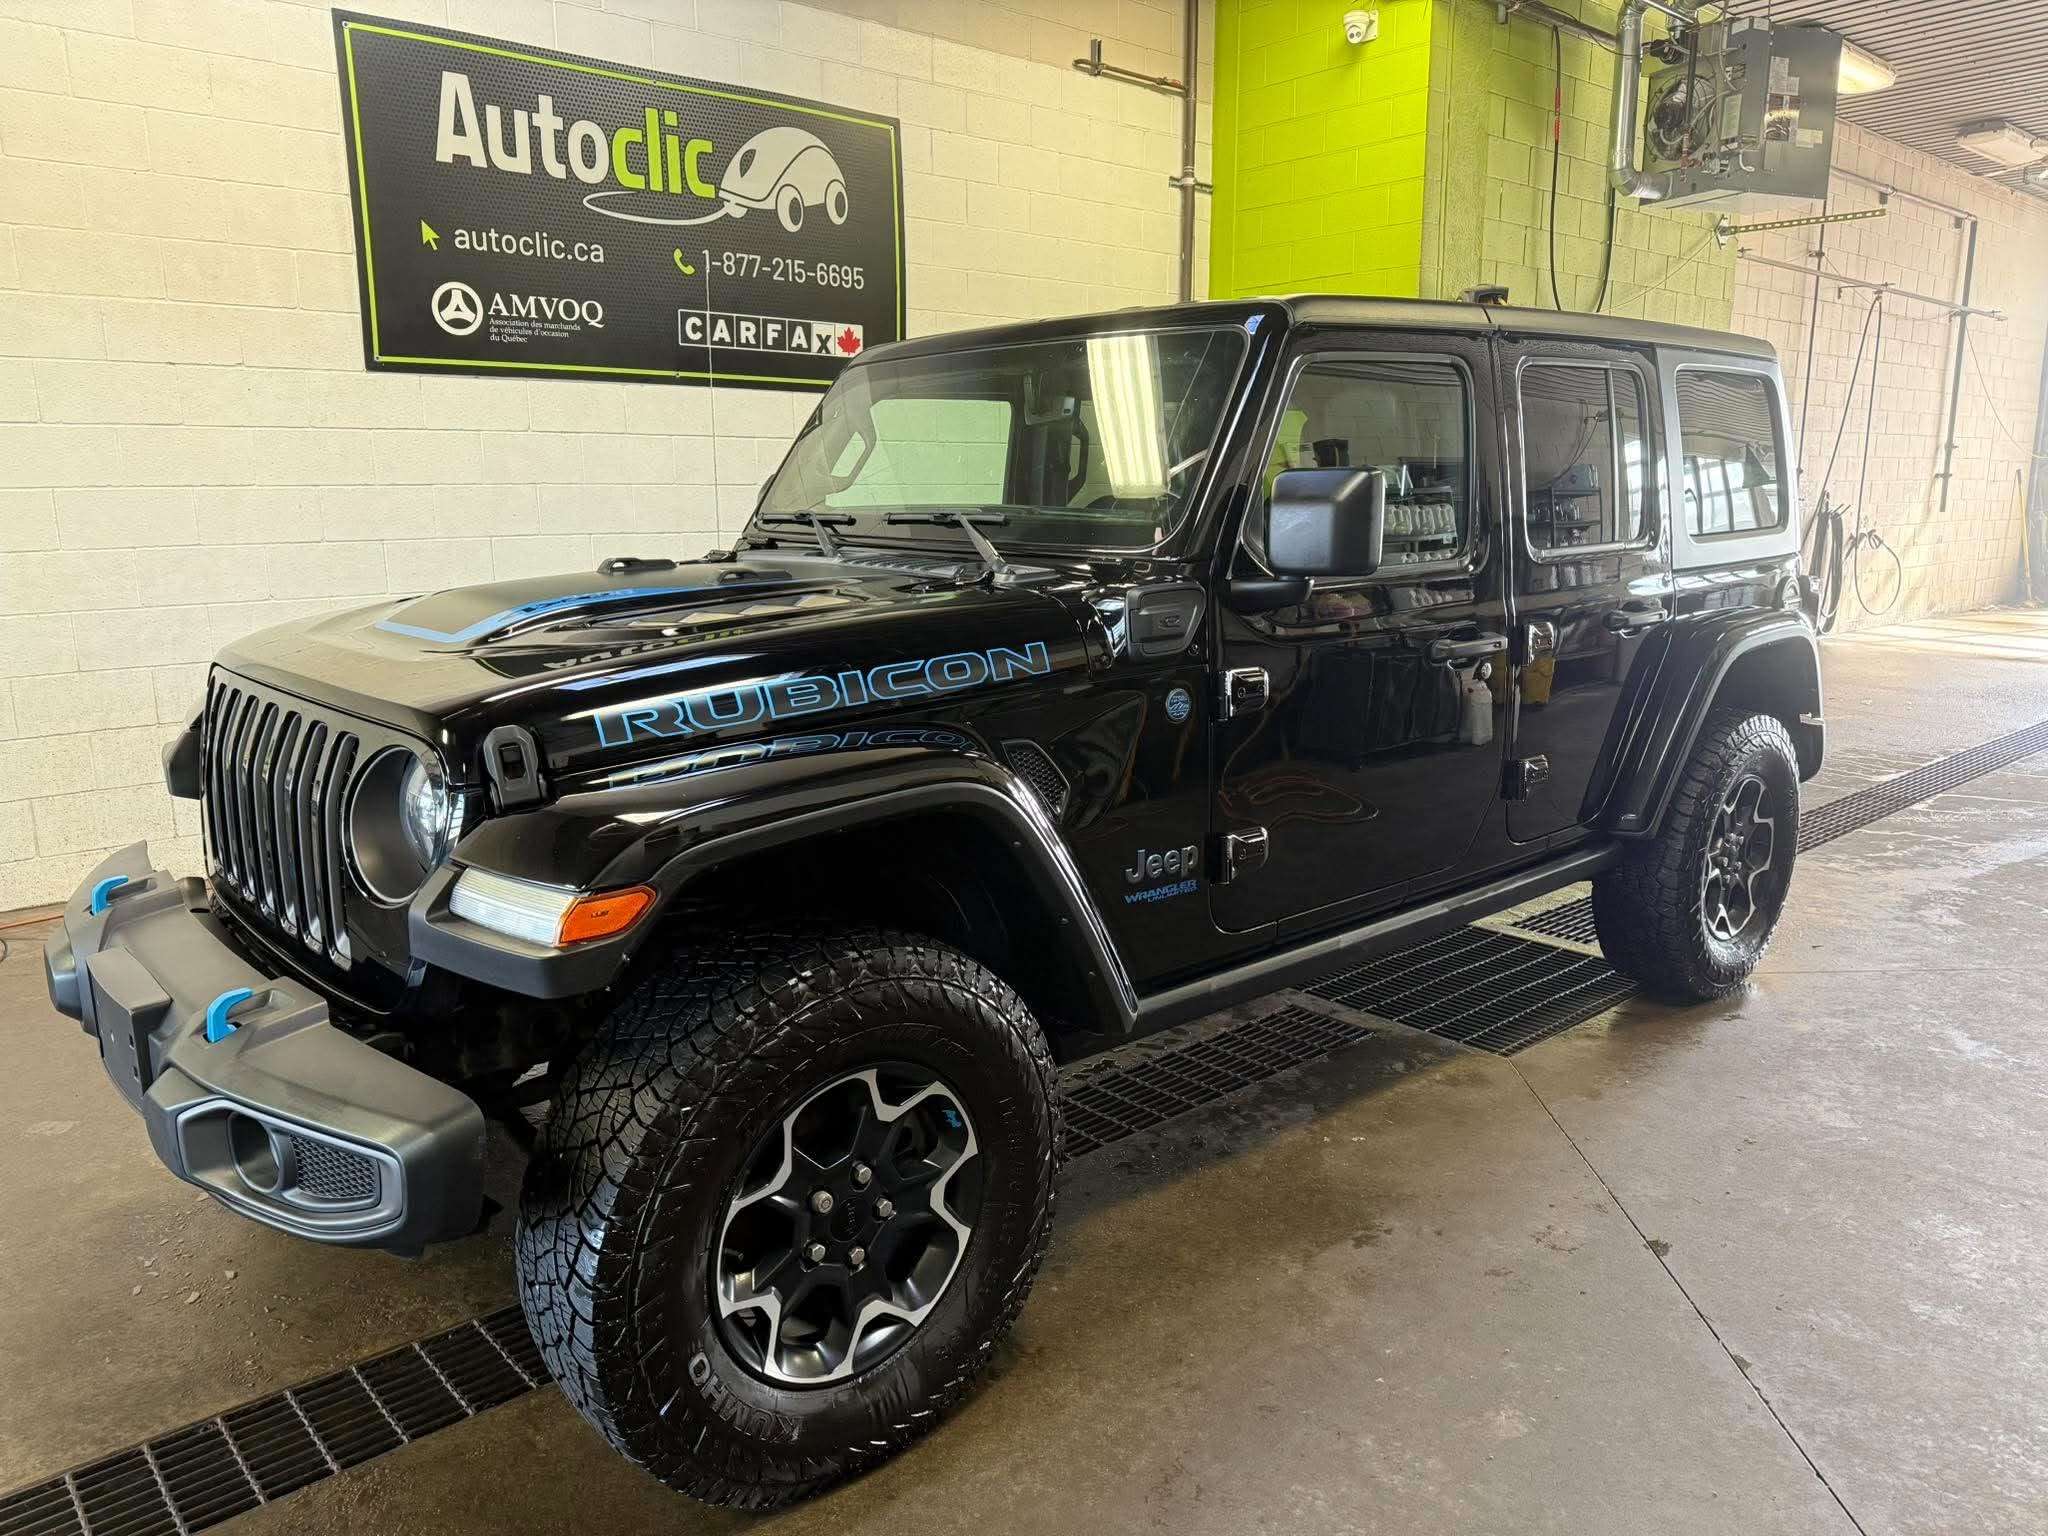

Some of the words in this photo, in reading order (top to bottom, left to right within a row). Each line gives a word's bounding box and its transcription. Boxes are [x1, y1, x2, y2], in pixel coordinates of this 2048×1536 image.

[435, 70, 714, 199] Autoclic
[453, 227, 605, 264] autoclic.ca
[702, 249, 865, 290] 1-877-215-6695
[488, 292, 605, 328] AMVOQ
[489, 318, 529, 327] Association
[530, 320, 542, 328] des
[543, 321, 581, 331] marchands
[500, 326, 532, 335] véhicules
[501, 334, 528, 343] Québec
[684, 315, 833, 355] CARFAX
[593, 641, 1050, 748] RUBICON
[1125, 845, 1199, 883] Jeep
[1124, 880, 1198, 904] WRANGLER
[688, 1351, 800, 1443] KUMHO
